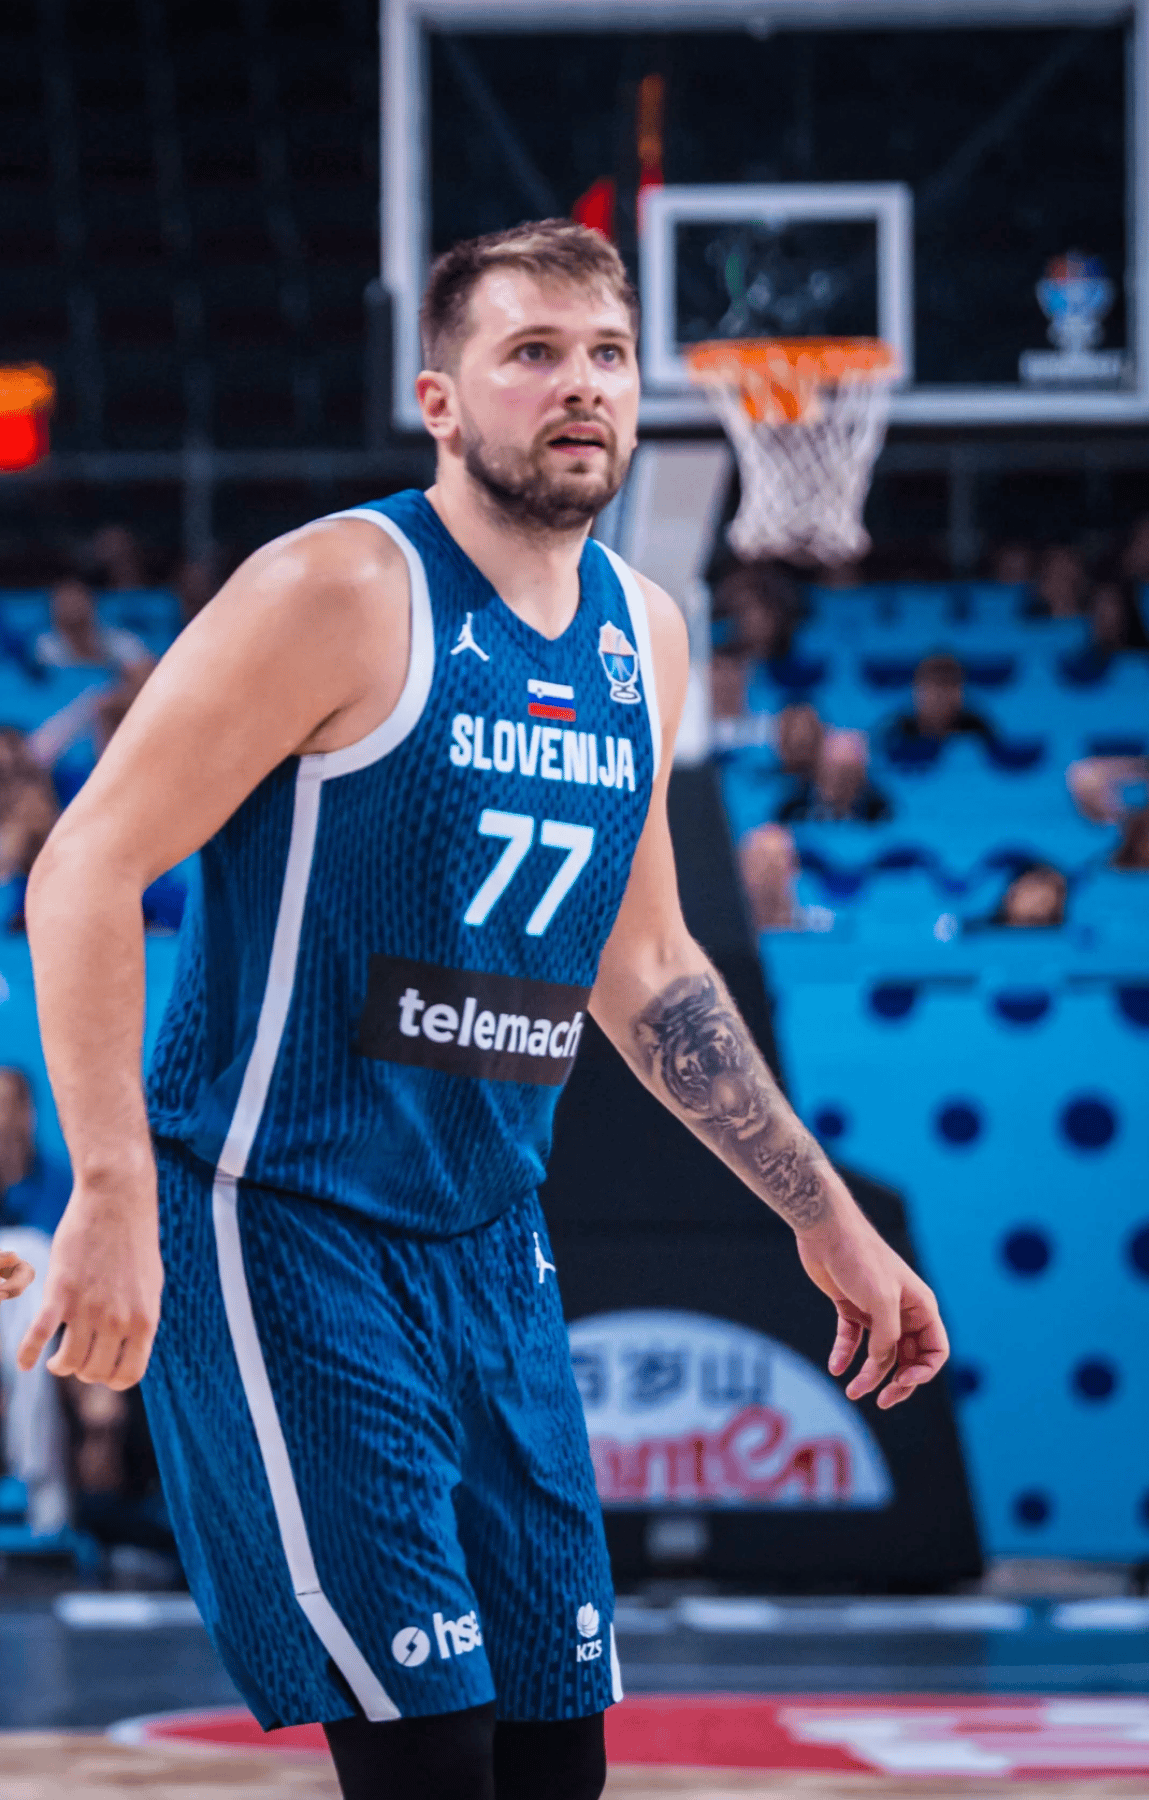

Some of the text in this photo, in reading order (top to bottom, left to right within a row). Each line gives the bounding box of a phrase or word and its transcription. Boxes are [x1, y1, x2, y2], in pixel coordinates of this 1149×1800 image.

[449, 714, 636, 792] SLOVENIJA
[462, 808, 596, 936] 77
[397, 987, 583, 1059] telemach
[576, 1639, 603, 1662] KZS
